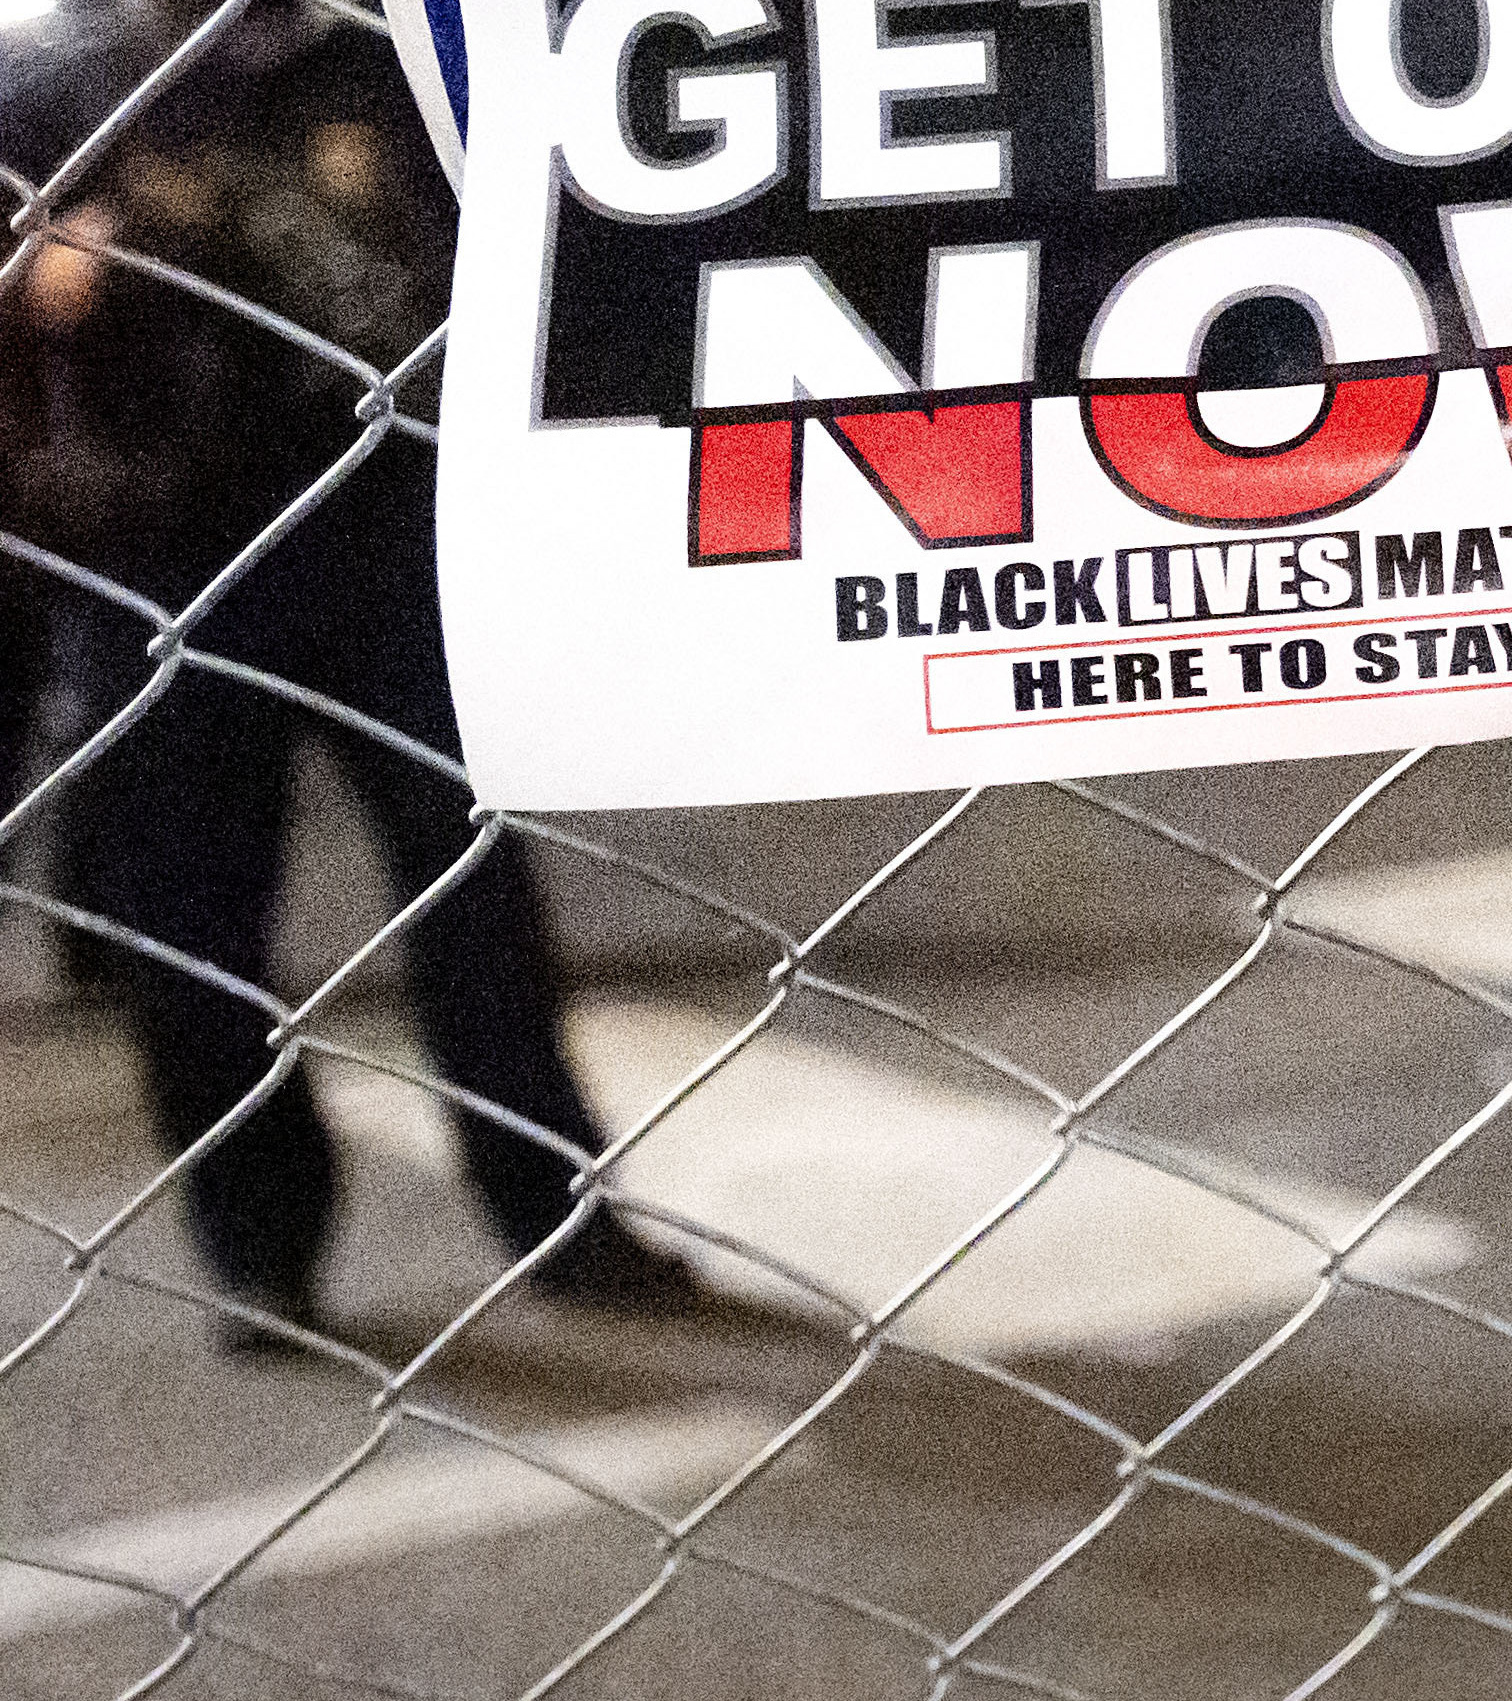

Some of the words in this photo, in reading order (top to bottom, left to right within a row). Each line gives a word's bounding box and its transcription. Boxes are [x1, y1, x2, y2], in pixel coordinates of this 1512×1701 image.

[835, 556, 1105, 642] BLACK
[1122, 536, 1360, 624] LIVES
[1012, 645, 1203, 712] HERE
[1230, 637, 1328, 691] TO
